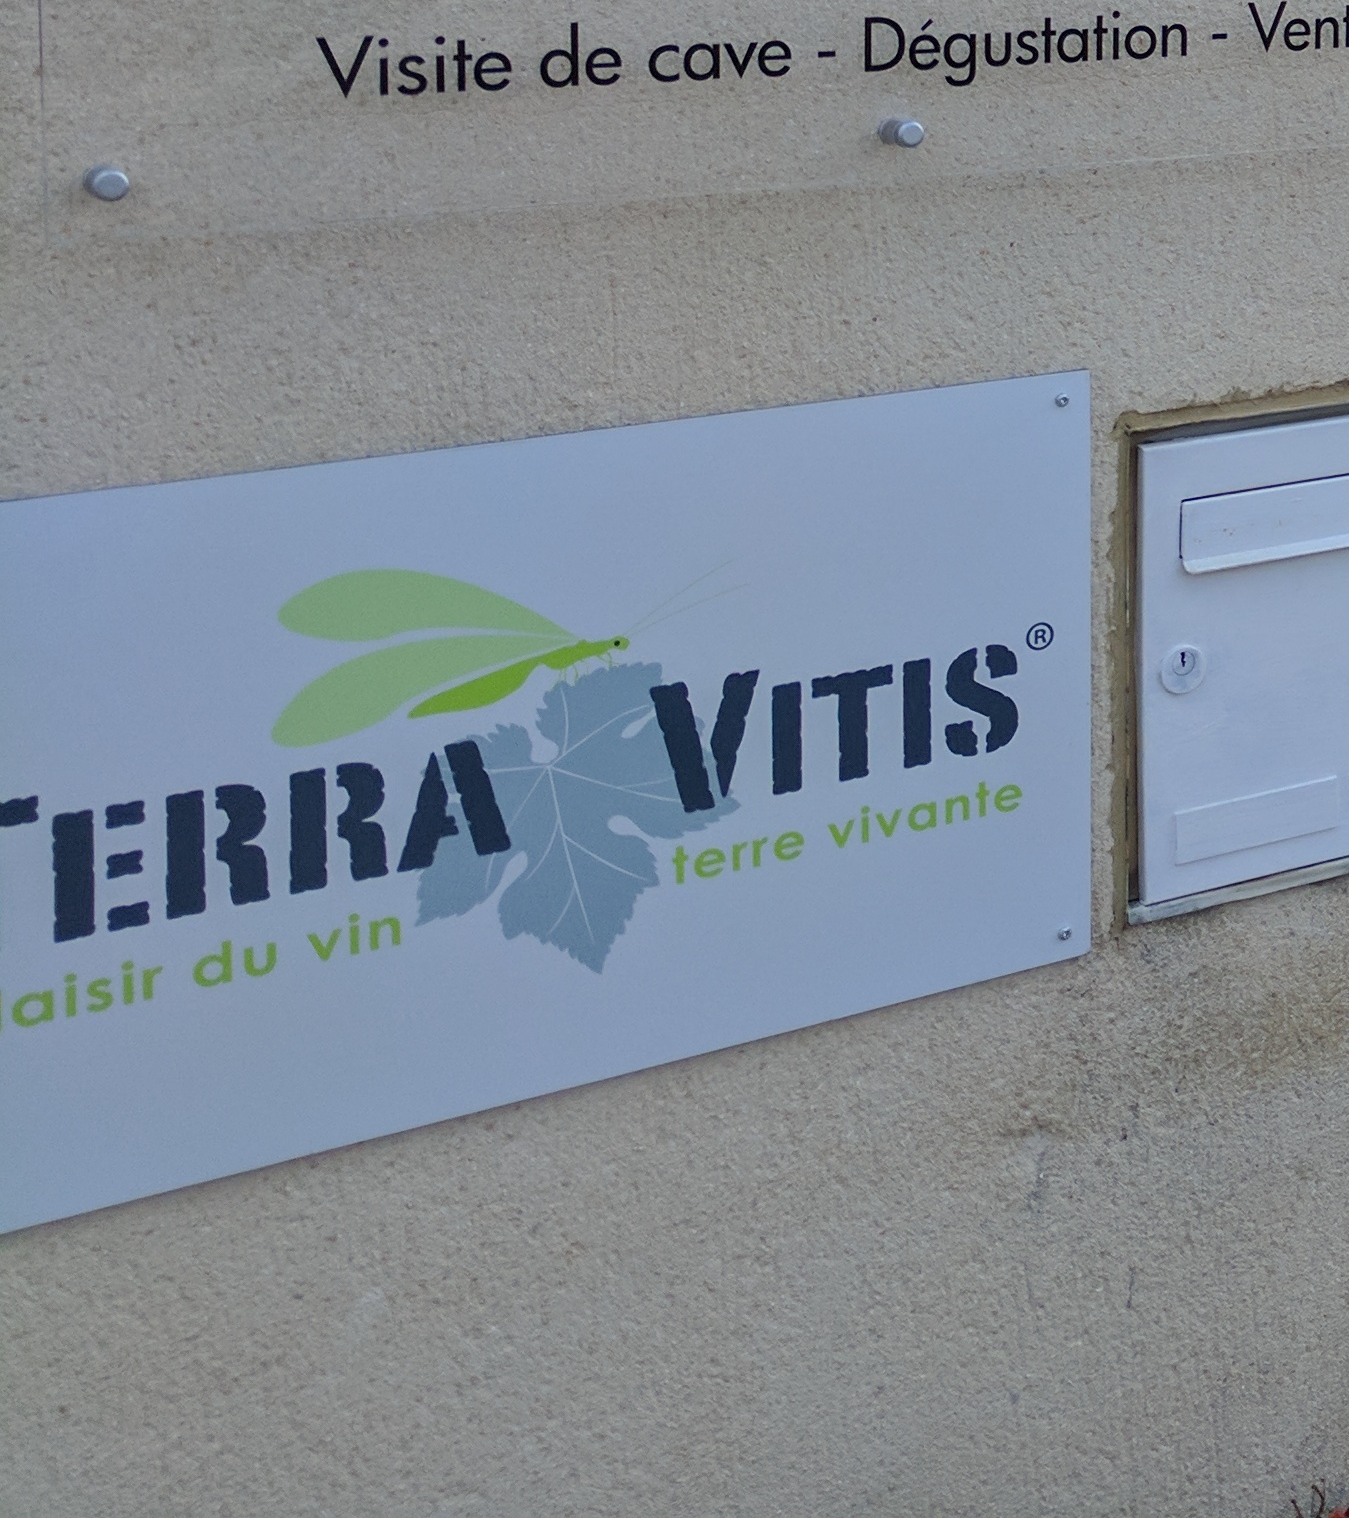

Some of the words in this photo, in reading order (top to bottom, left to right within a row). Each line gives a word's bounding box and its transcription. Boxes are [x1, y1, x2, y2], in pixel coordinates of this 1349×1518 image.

[315, 34, 513, 99] Visite
[539, 22, 623, 88] de
[648, 38, 792, 84] cave
[863, 10, 1189, 87] Dégustation
[671, 830, 805, 885] terre
[827, 781, 1024, 849] vivante
[0, 960, 164, 1032] aisir
[192, 939, 278, 988] du
[306, 913, 402, 962] vin
